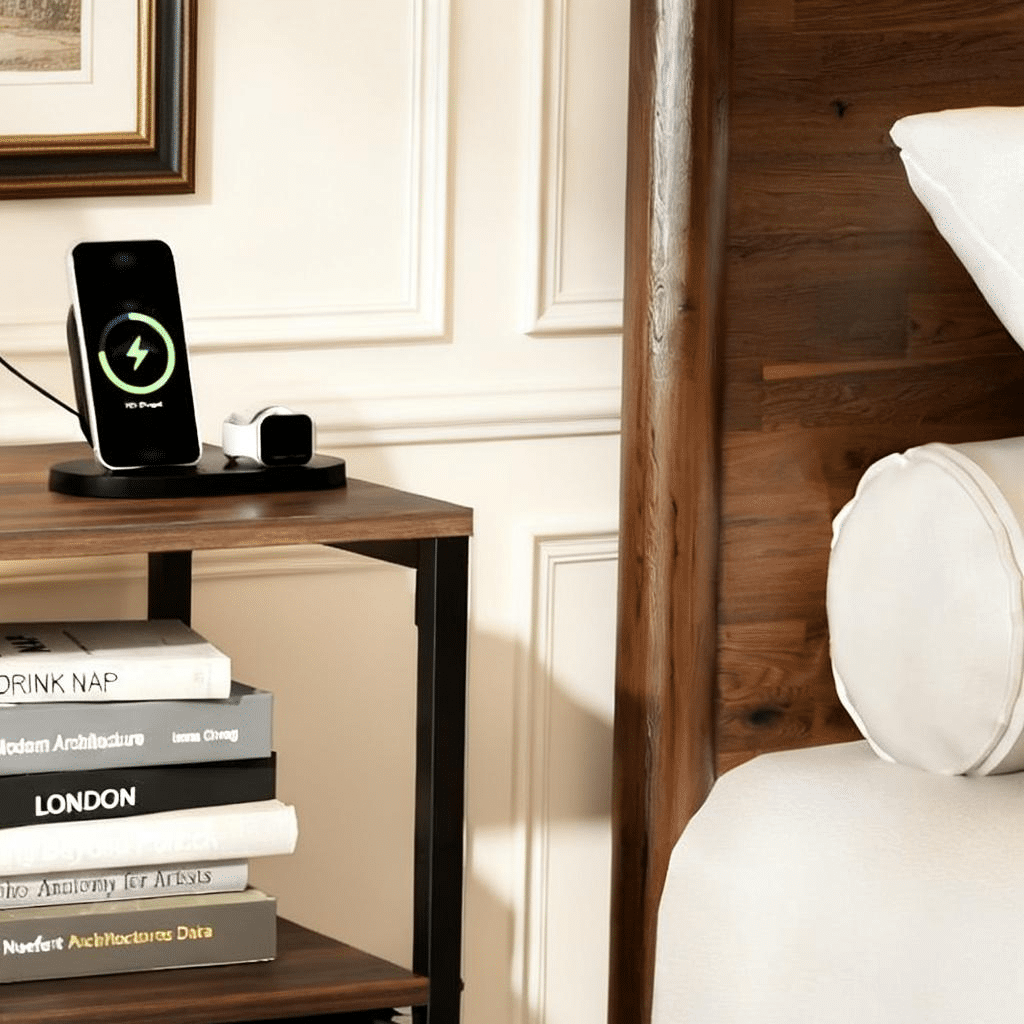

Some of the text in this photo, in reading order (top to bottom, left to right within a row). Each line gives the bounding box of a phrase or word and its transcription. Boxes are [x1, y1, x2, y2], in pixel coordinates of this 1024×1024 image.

[72, 671, 118, 693] NAP
[34, 786, 136, 818] LONDON
[124, 872, 149, 890] for
[177, 925, 214, 941] Data
